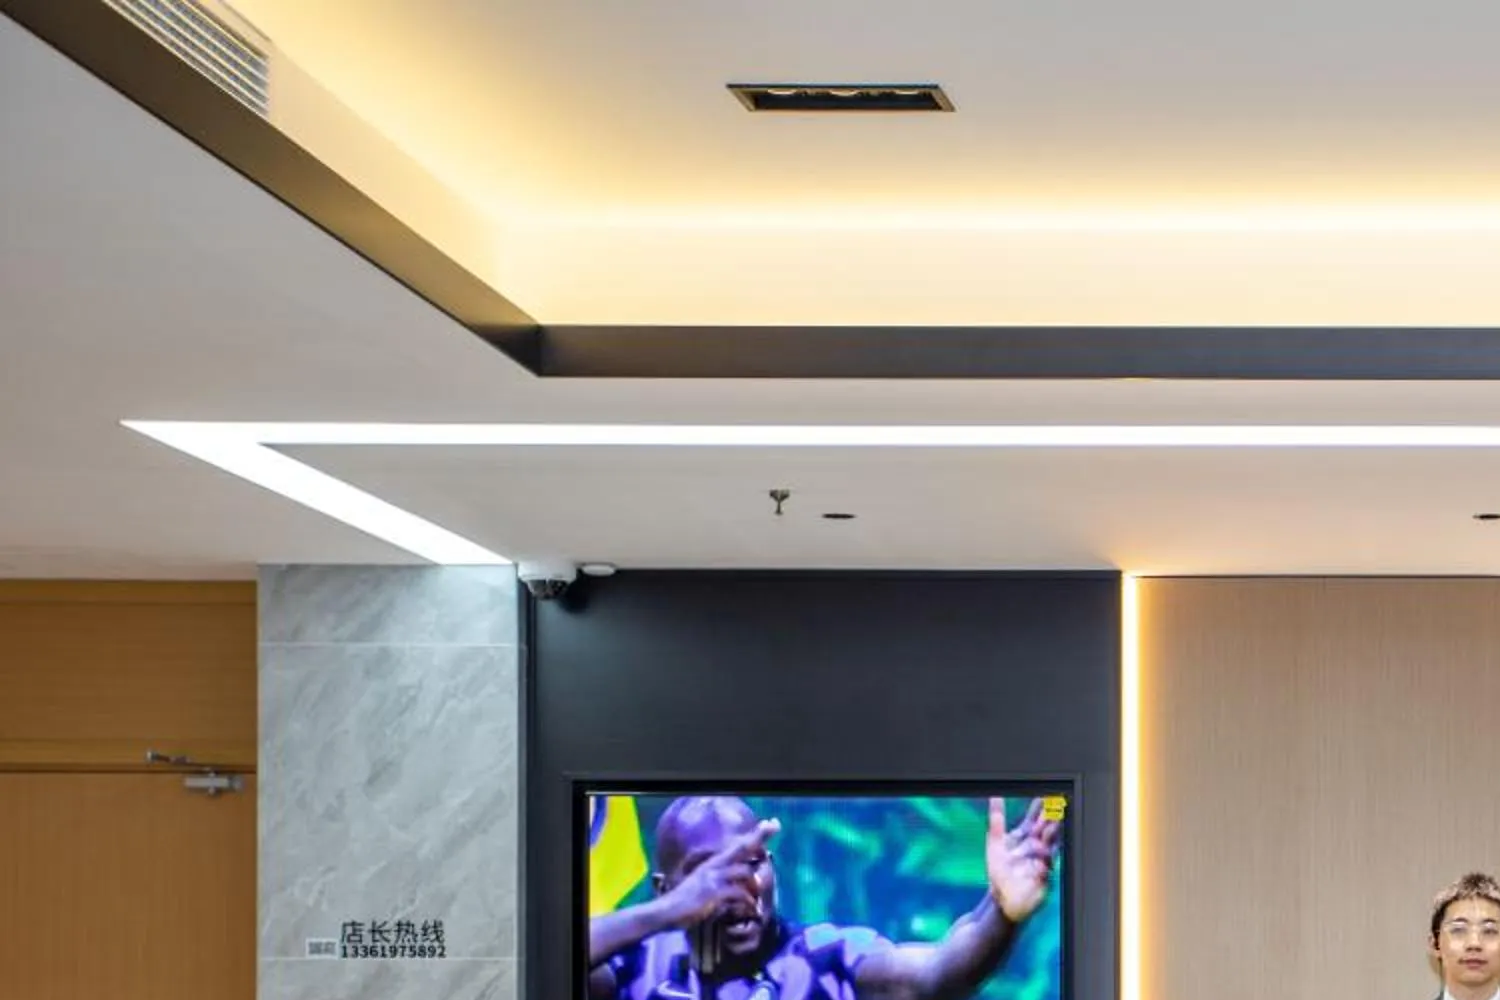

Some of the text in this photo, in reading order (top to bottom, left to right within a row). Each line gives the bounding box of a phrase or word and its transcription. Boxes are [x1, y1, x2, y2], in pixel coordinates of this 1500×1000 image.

[340, 919, 446, 944] 店长热线
[340, 944, 447, 959] 13361975892
